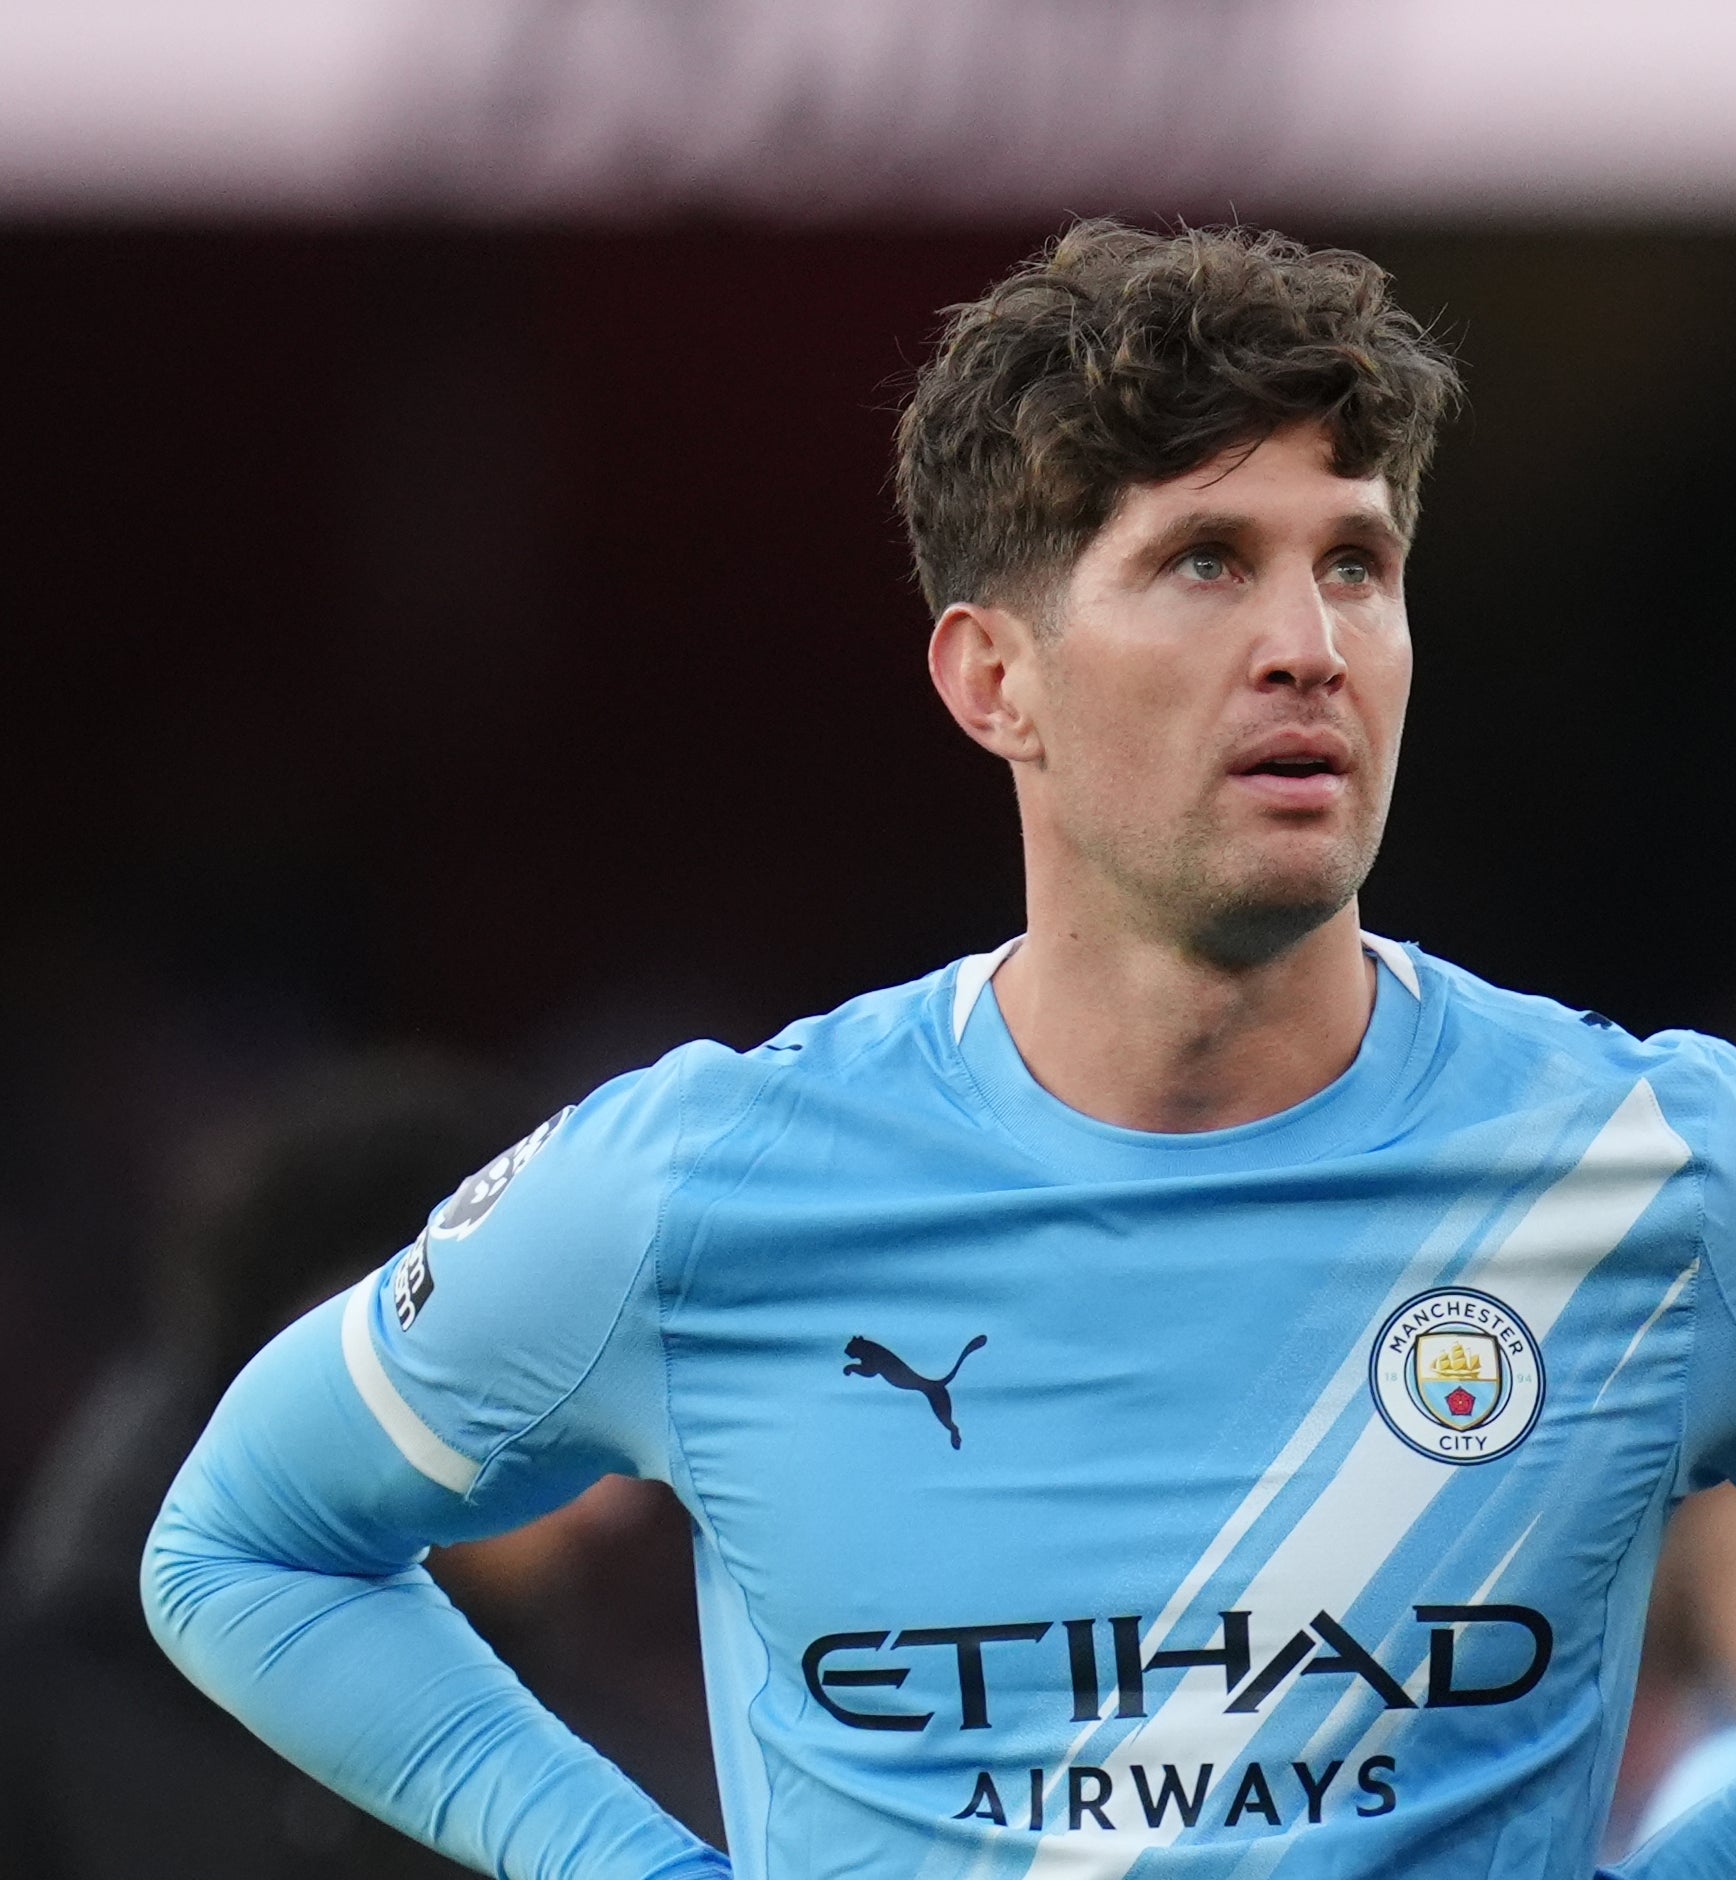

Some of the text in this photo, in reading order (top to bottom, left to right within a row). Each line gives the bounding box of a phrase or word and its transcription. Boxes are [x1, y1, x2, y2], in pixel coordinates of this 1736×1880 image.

[1389, 1301, 1524, 1356] MANCHESTER
[1439, 1435, 1488, 1451] CITY
[802, 1604, 1554, 1732] ETIHAD
[951, 1754, 1398, 1832] AIRWAYS
